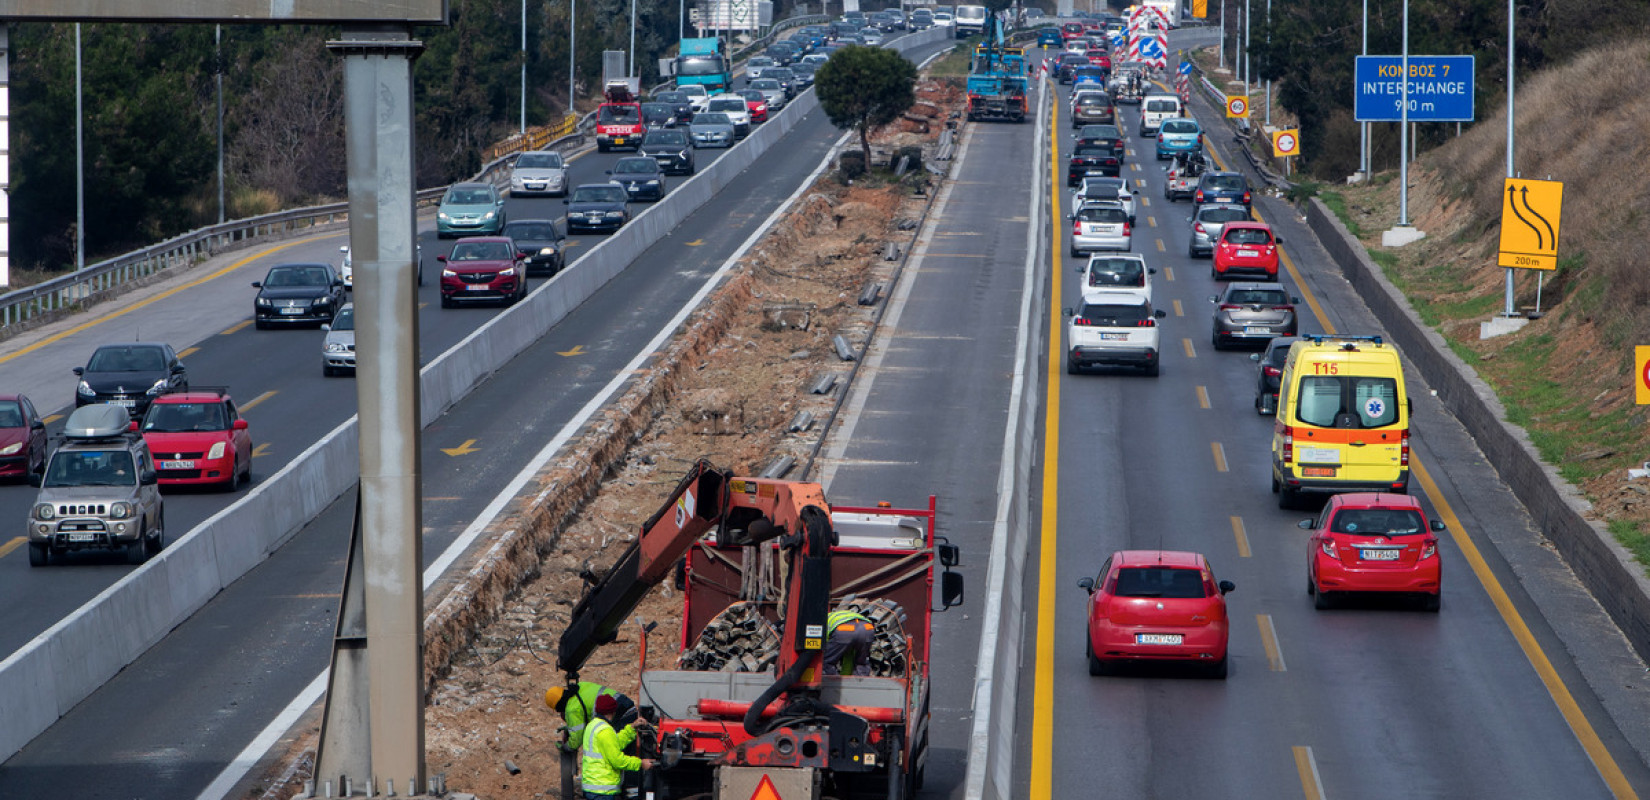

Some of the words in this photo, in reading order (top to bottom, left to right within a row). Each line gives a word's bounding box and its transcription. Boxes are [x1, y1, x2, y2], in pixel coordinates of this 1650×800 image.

[1442, 65, 1450, 77] 7
[1363, 82, 1466, 94] INTERCHANGE
[1395, 99, 1417, 112] 90
[1421, 102, 1434, 112] m
[1313, 363, 1338, 375] T15
